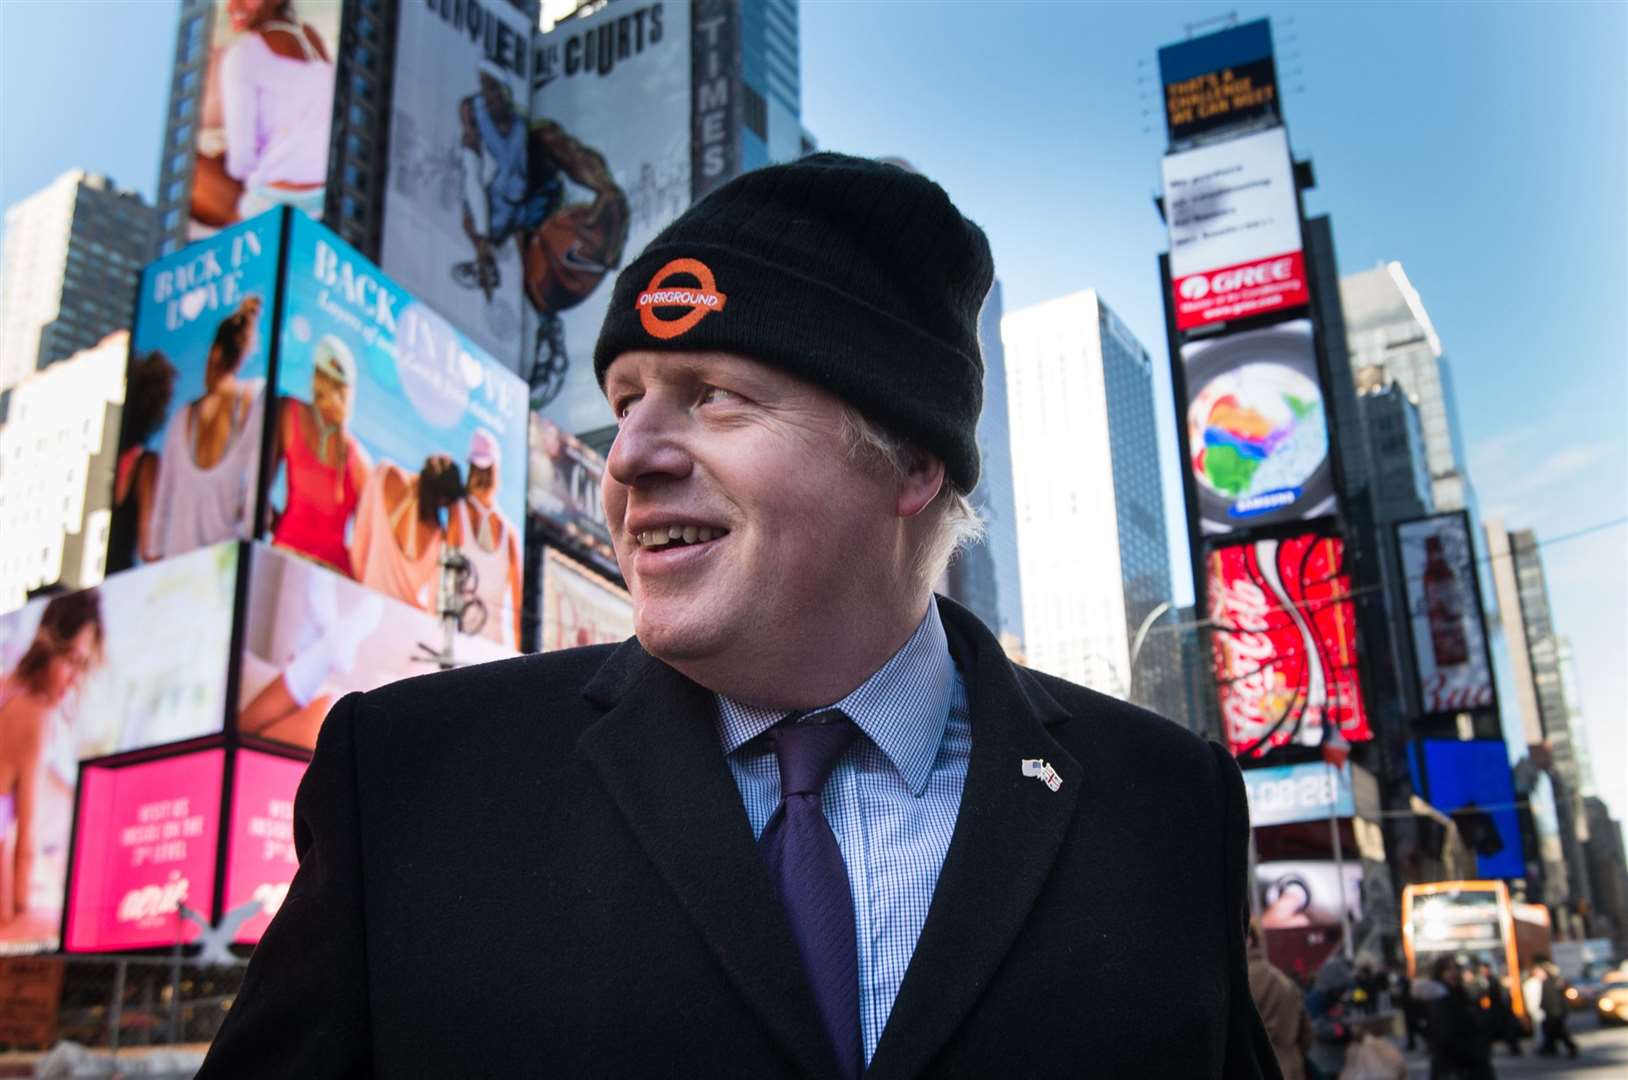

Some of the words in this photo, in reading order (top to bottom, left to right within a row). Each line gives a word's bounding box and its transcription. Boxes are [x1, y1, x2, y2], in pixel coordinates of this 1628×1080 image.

[564, 3, 664, 77] COURTS
[698, 16, 729, 176] TIMES
[153, 247, 222, 304] BACK
[314, 239, 397, 333] BACK
[640, 291, 718, 305] OVERGROUND
[1211, 257, 1293, 293] GREE
[1235, 490, 1295, 512] SAMSUNG
